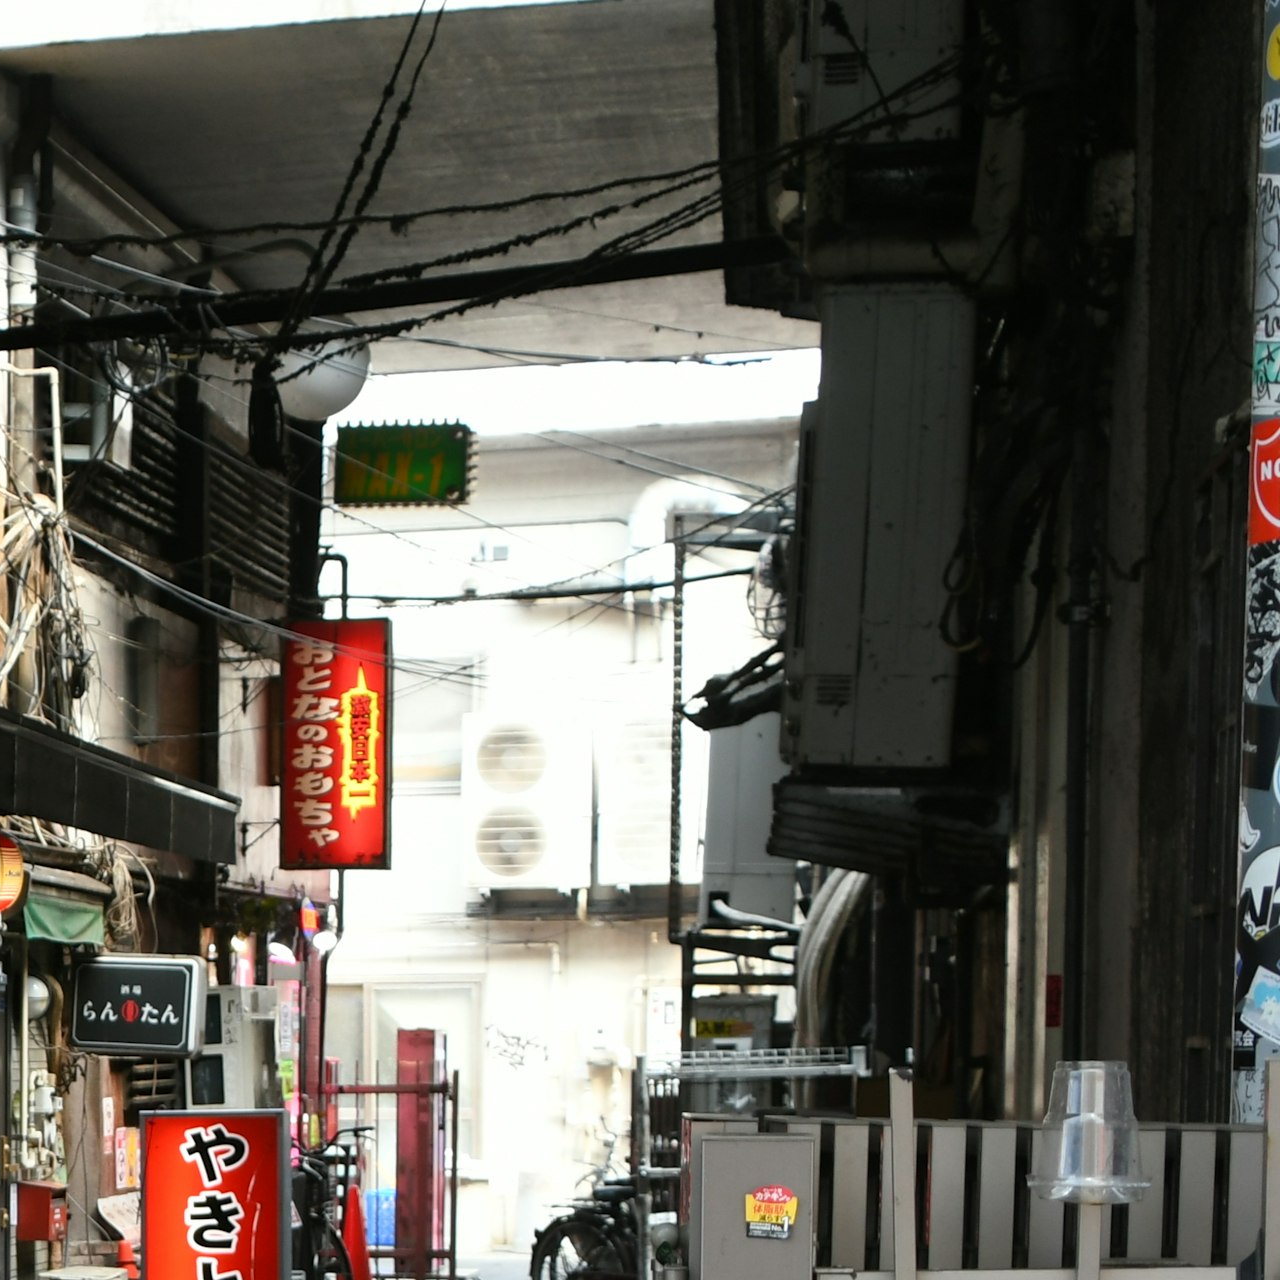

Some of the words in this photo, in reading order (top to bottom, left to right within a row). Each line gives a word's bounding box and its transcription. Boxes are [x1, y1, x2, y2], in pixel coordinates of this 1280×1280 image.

[291, 642, 340, 847] おとなのおもちゃ
